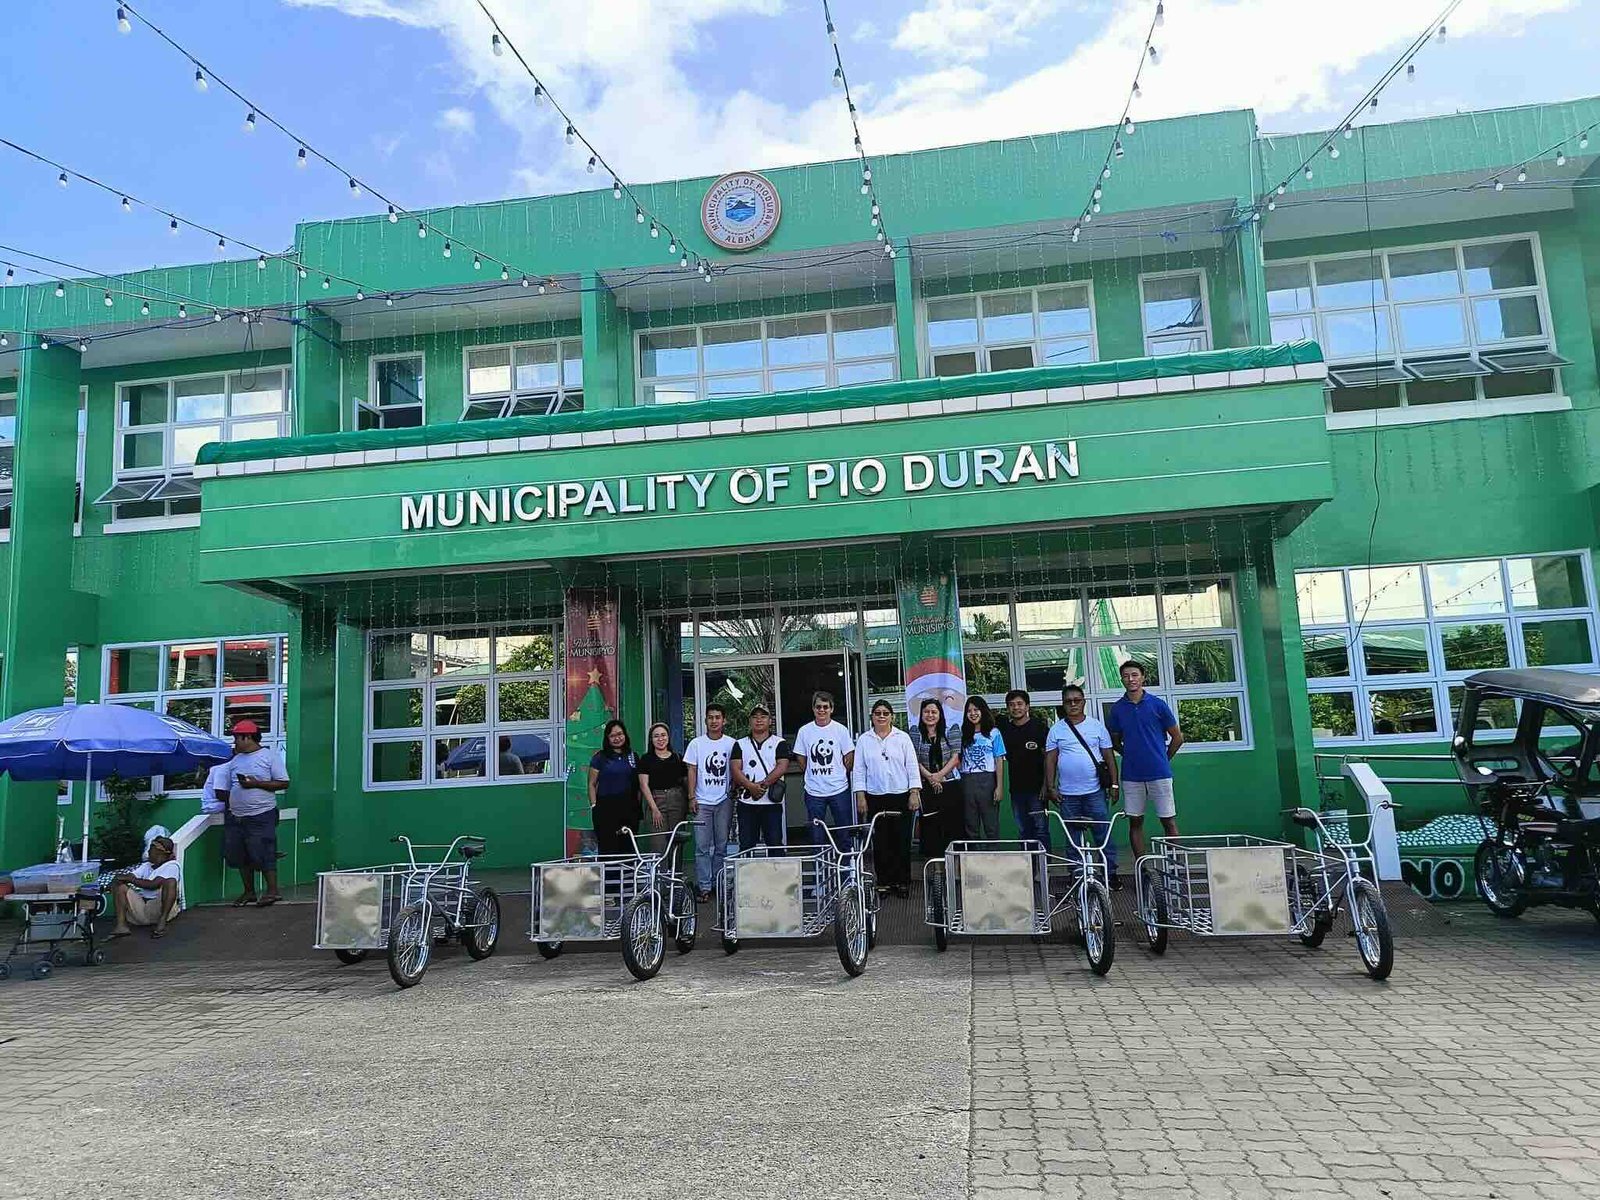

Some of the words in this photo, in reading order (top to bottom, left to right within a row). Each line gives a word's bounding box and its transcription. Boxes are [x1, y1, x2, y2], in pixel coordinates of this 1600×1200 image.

[743, 178, 755, 186] OF
[725, 232, 756, 243] ALBAY
[401, 472, 717, 531] MUNICIPALITY
[728, 465, 791, 504] OF
[807, 458, 888, 500] PIO
[902, 440, 1080, 492] DURAN
[810, 767, 834, 776] WWF
[704, 777, 727, 787] WWF
[1400, 858, 1466, 899] NO
